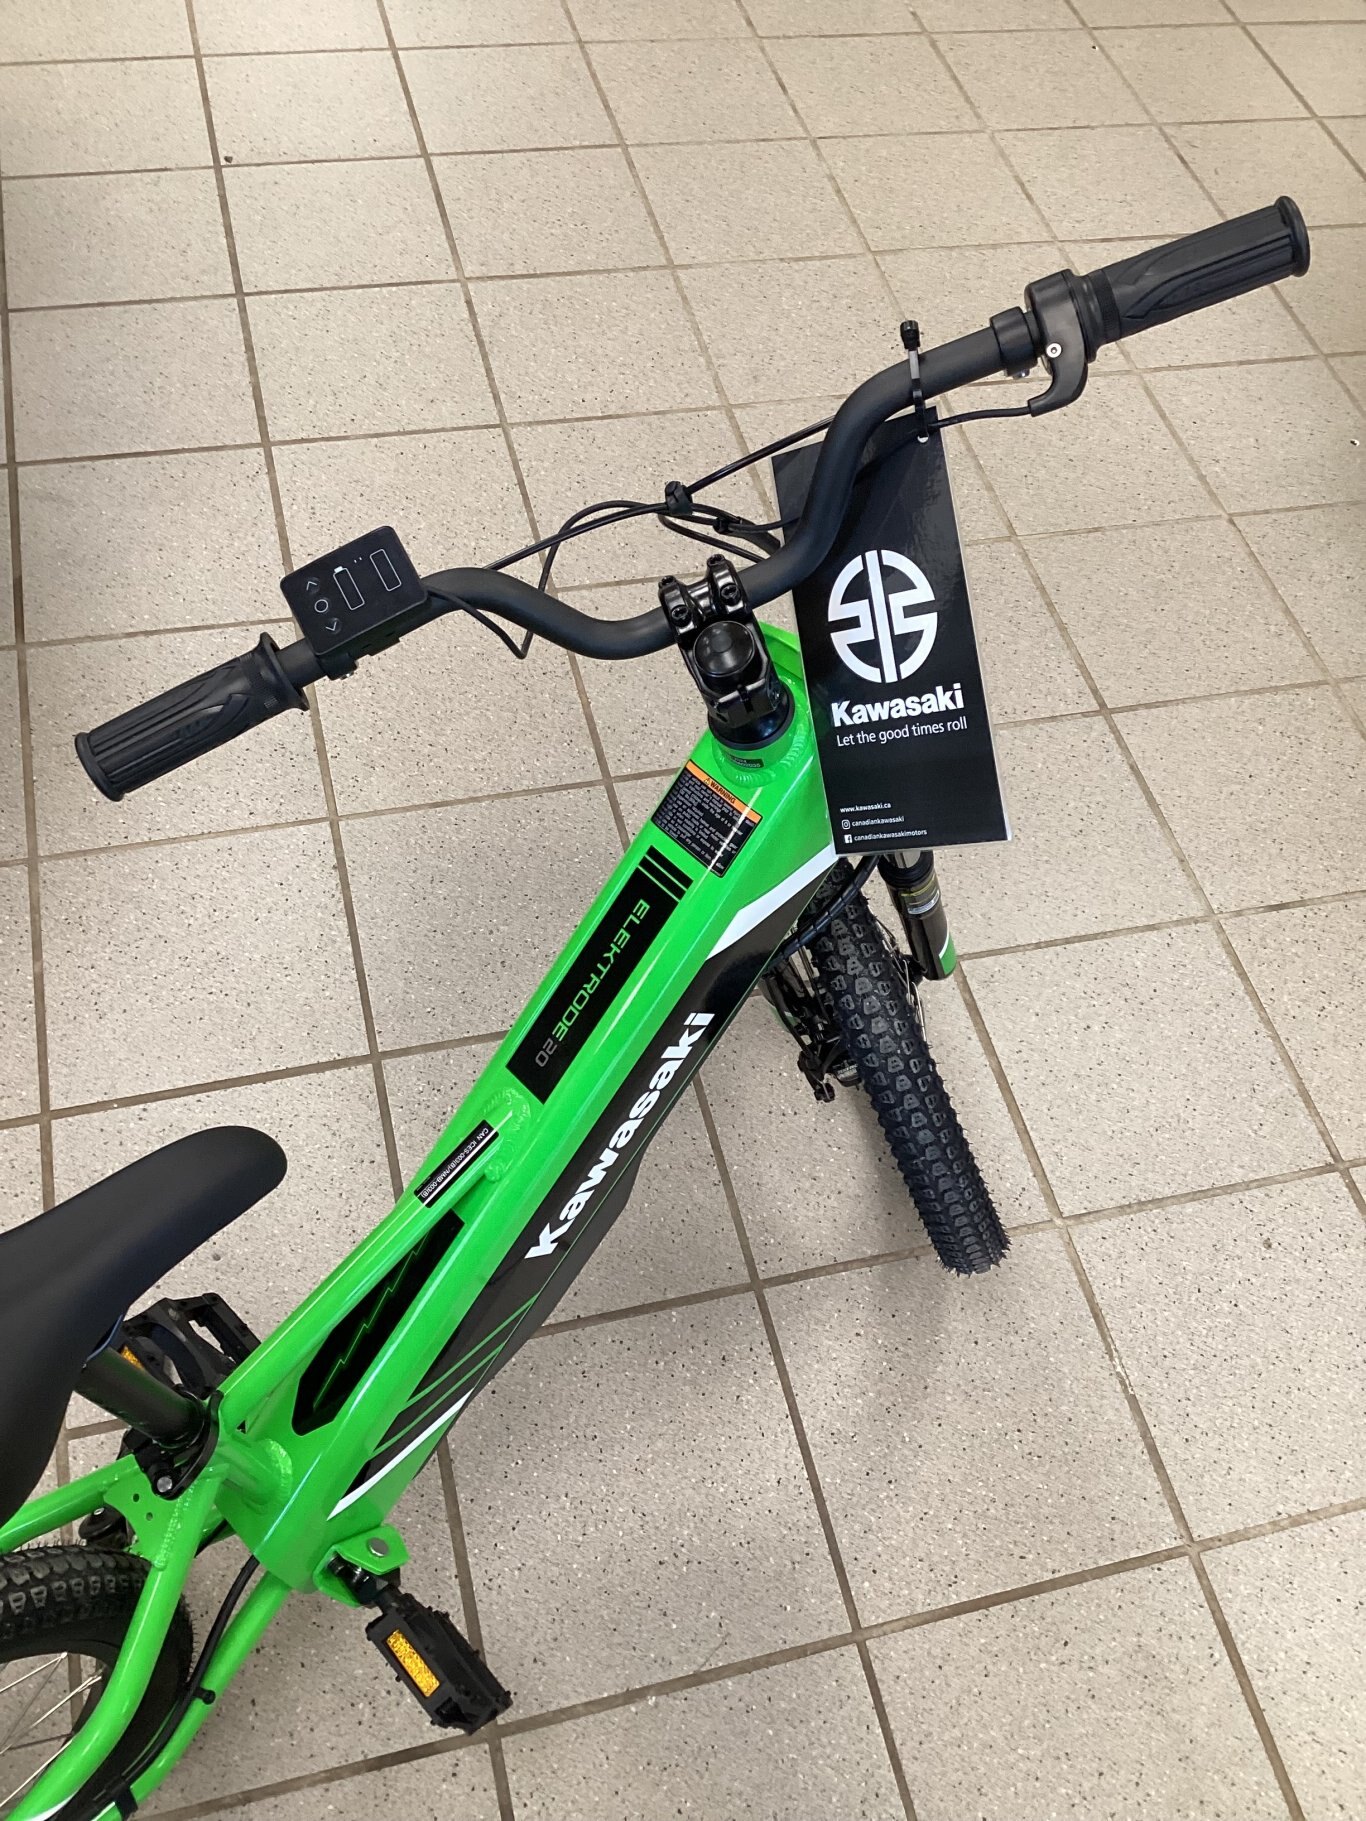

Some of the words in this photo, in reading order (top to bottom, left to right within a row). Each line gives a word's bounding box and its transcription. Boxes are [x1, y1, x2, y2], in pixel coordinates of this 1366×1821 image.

[831, 683, 965, 727] Kawasaki
[836, 734, 856, 747] Let
[856, 730, 877, 744] the
[879, 724, 910, 745] good
[911, 722, 945, 736] times
[946, 716, 968, 732] roll
[710, 780, 737, 804] WARNING
[840, 803, 892, 813] www.kawasaki.ca
[852, 816, 905, 827] canadiankawasaki
[854, 830, 928, 841] canadiankawasakimotors
[551, 898, 650, 1042] ELEKTRODE
[535, 1039, 558, 1068] 20
[476, 1127, 489, 1141] CAN
[525, 1012, 716, 1259] Kawasaki
